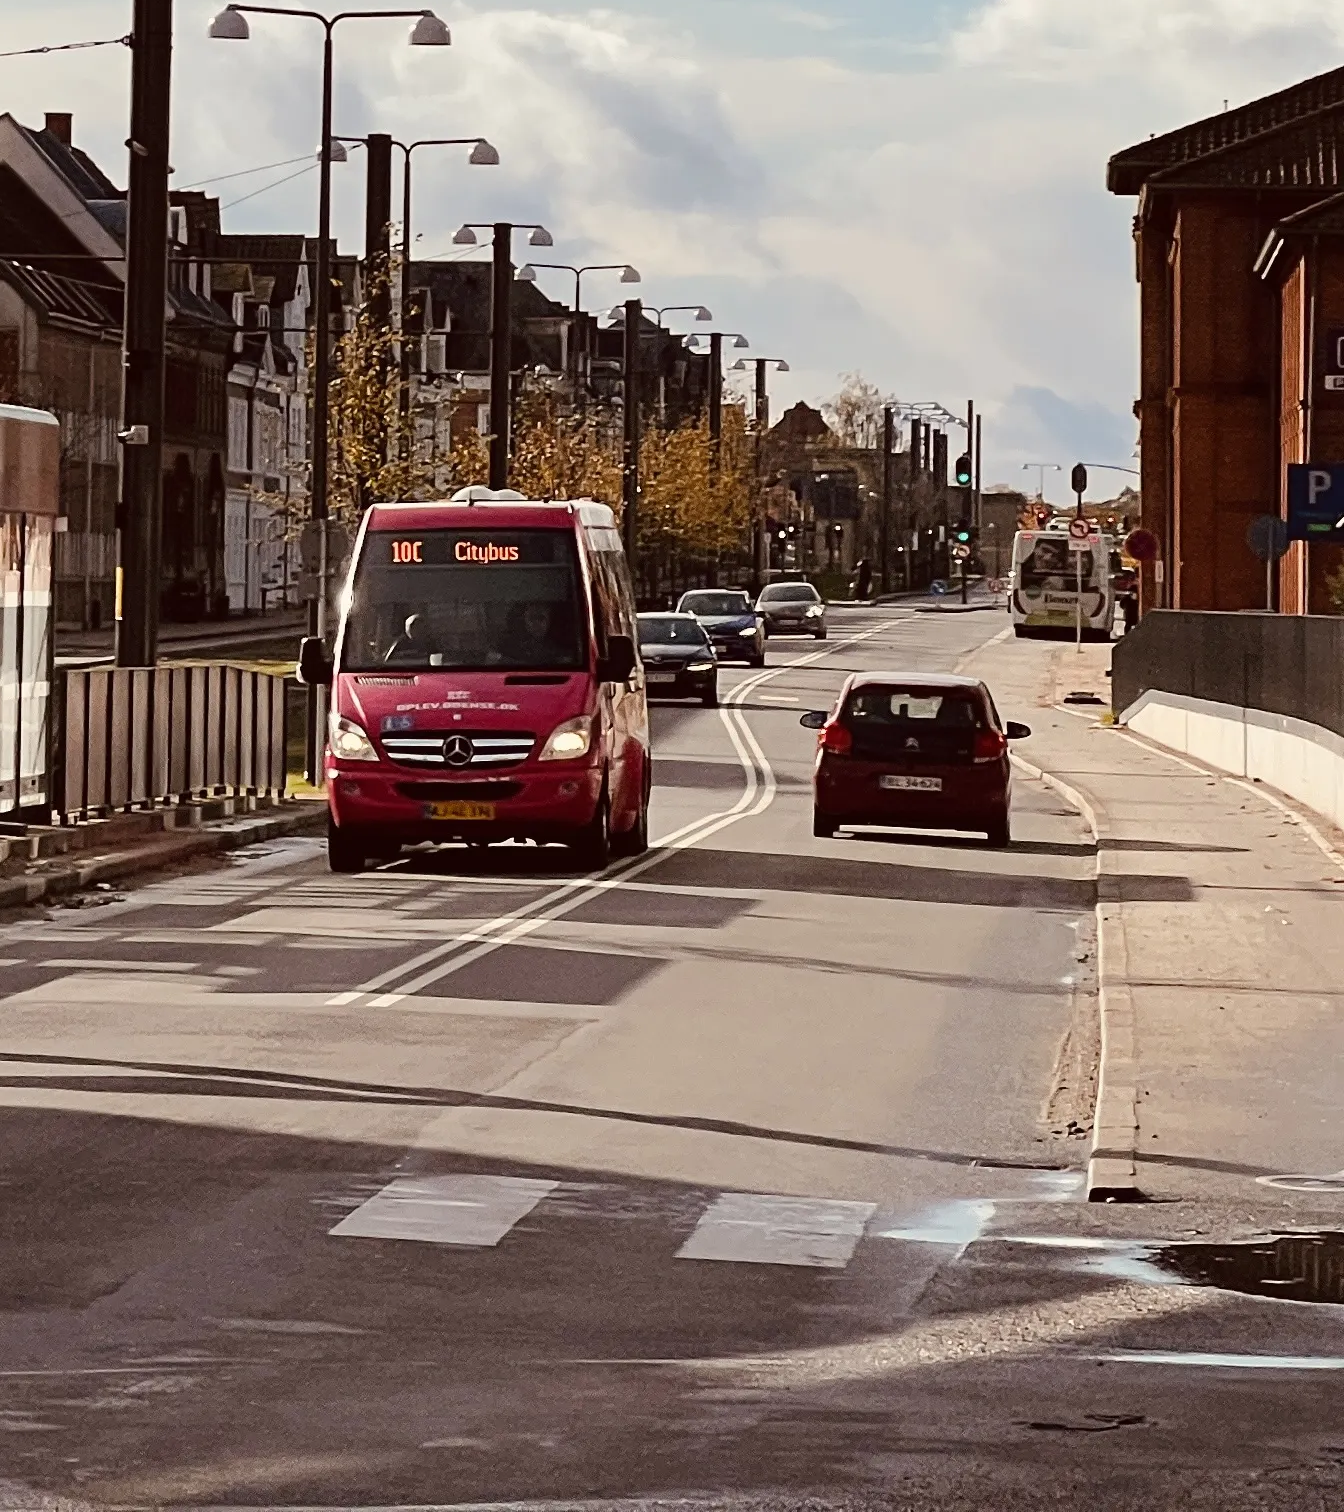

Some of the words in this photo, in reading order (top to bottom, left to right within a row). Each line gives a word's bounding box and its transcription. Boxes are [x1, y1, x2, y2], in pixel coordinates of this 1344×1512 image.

[1308, 470, 1332, 504] P
[391, 541, 423, 563] 10C
[454, 541, 519, 564] Citybus
